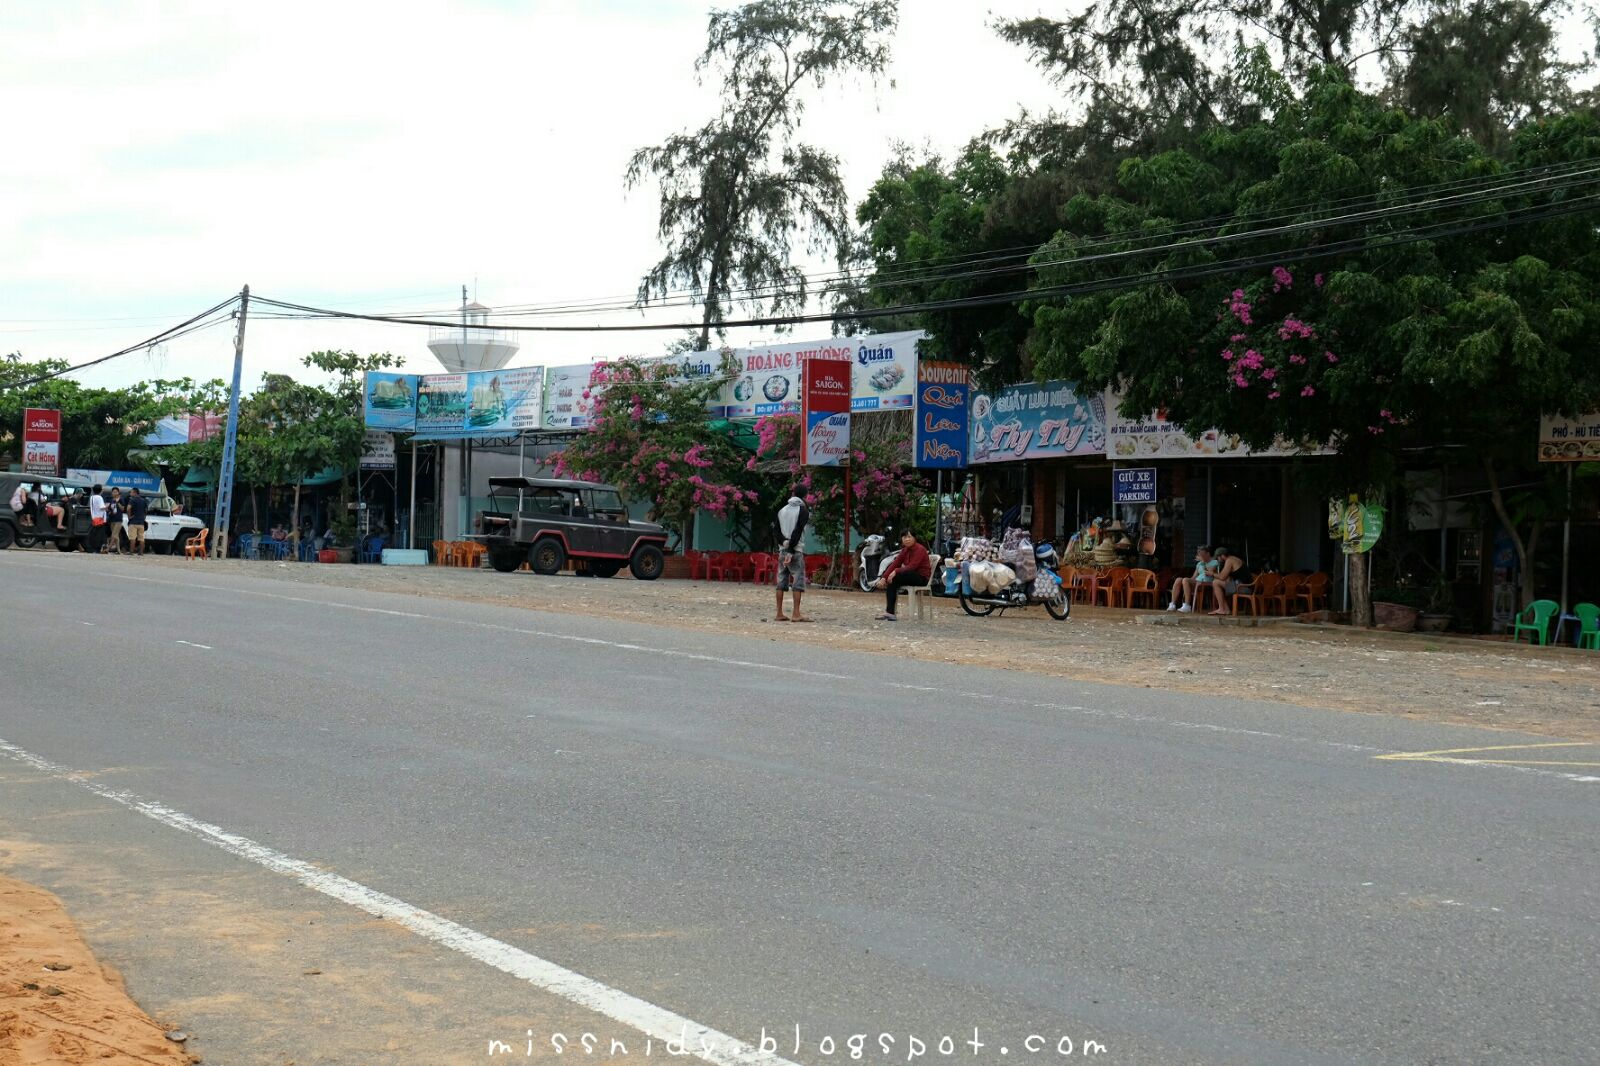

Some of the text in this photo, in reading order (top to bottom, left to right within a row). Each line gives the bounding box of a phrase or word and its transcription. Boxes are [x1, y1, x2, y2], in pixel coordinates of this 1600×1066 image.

[747, 350, 792, 372] HOÀNG
[859, 346, 894, 368] Quán
[920, 362, 968, 384] Souvenir
[815, 380, 844, 390] SAIGON
[829, 416, 848, 427] QUÁN
[990, 418, 1085, 457] Thy Thy
[1118, 471, 1150, 482] GIỮ XE
[1119, 492, 1150, 502] PARKING
